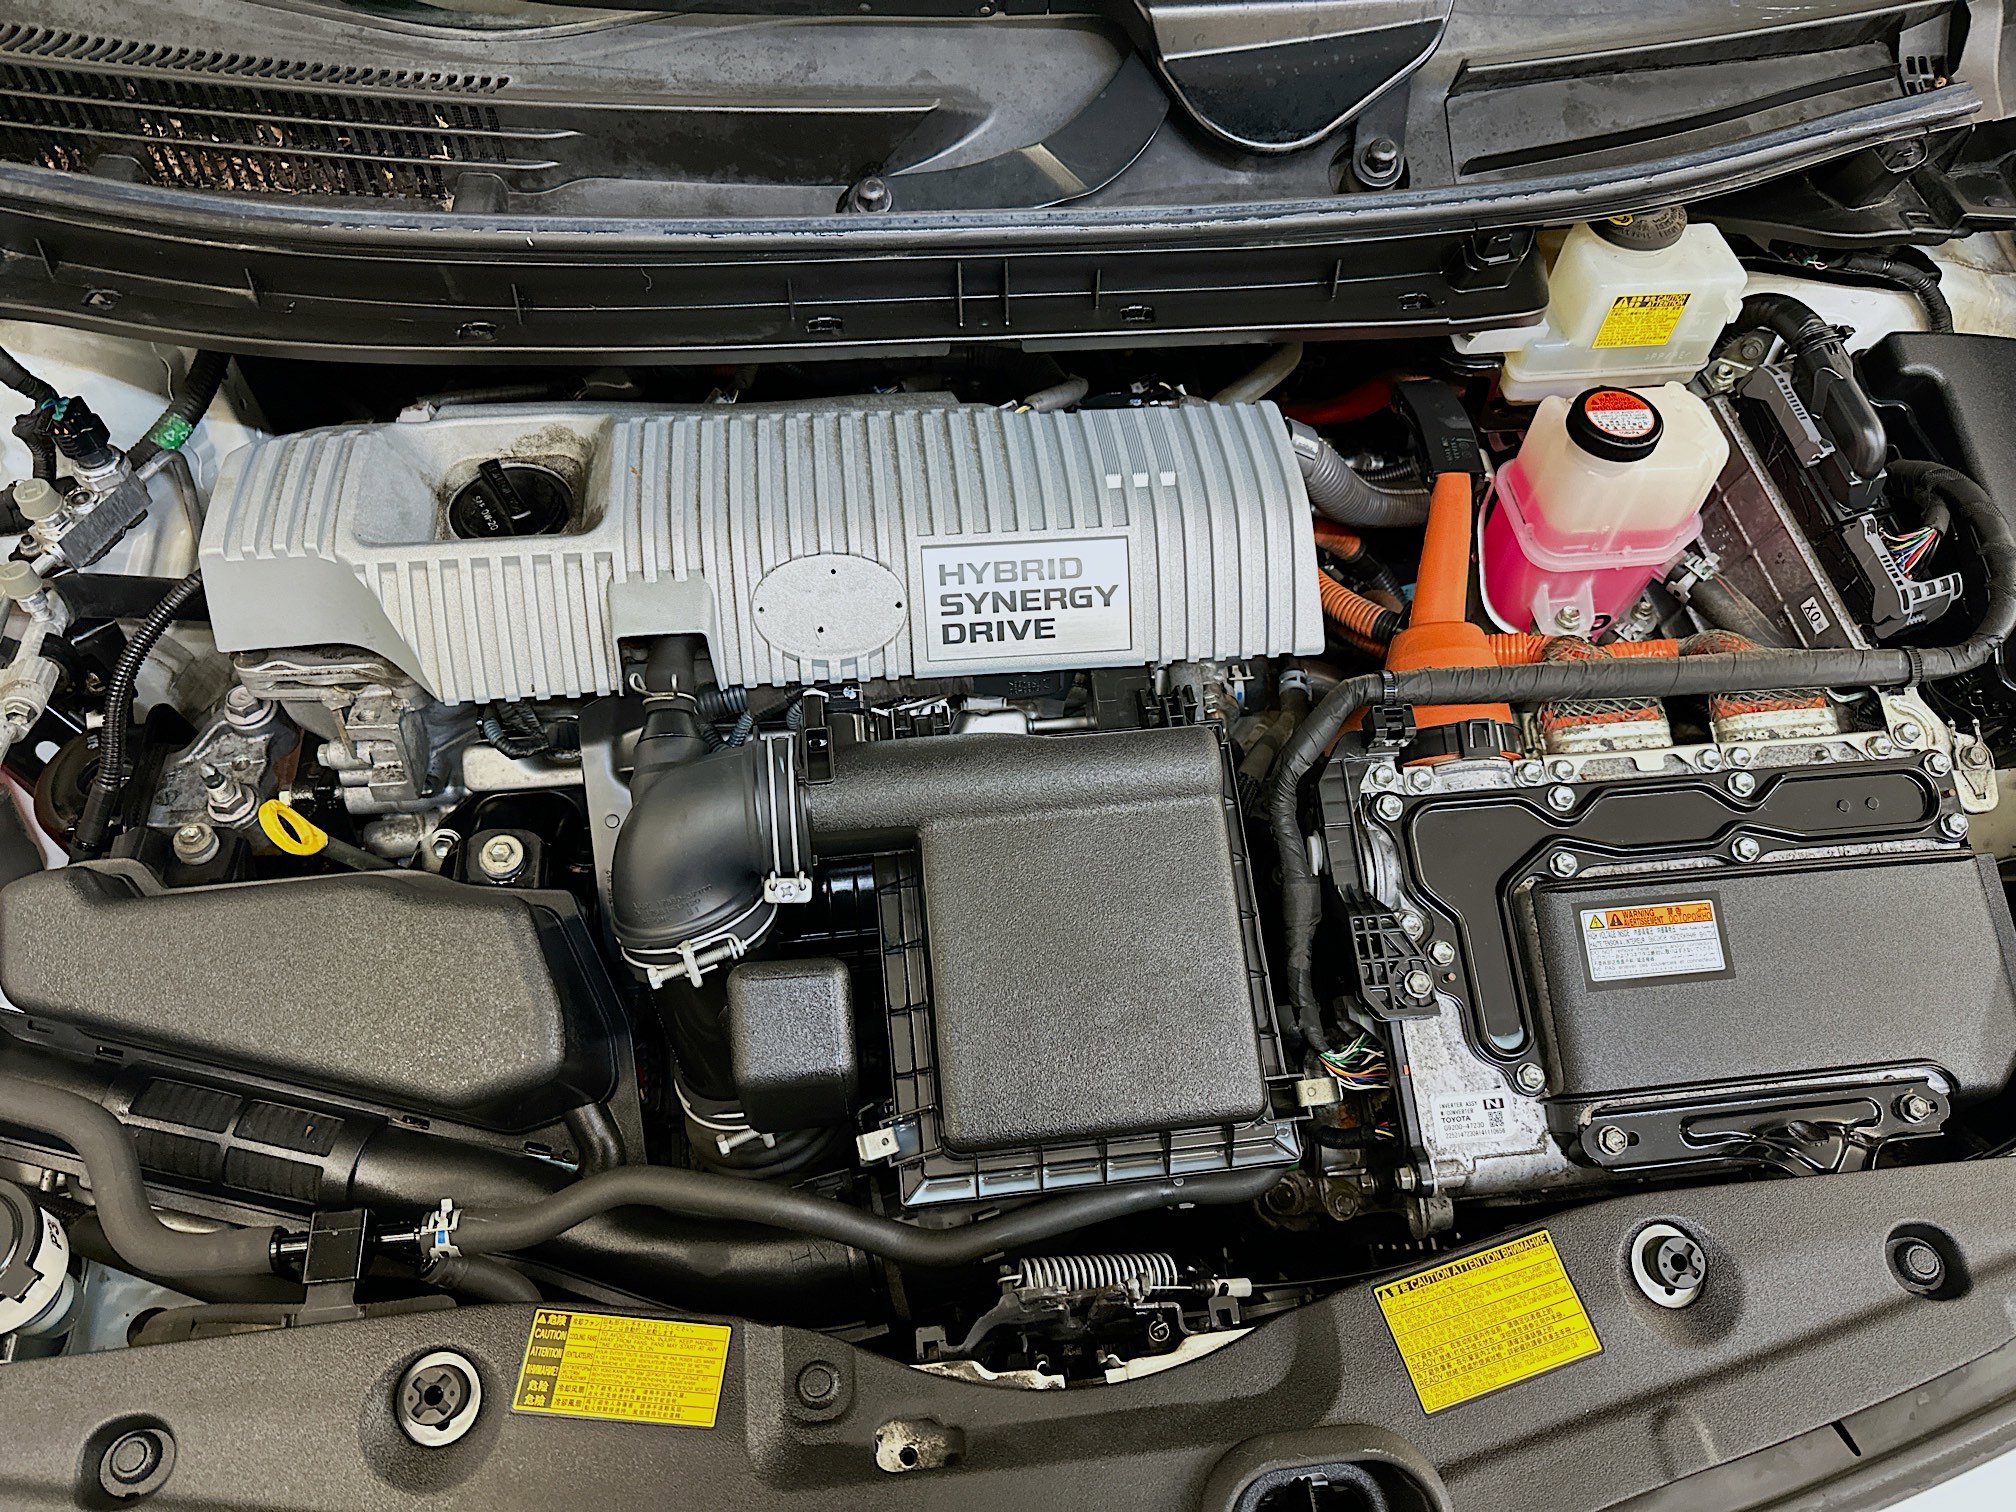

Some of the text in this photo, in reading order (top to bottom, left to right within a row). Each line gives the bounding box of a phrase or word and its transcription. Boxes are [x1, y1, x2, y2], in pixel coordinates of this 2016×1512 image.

[938, 557, 1083, 587] HYBRID
[940, 584, 1119, 617] SYNERGY
[941, 617, 1056, 645] DRIVE
[1622, 909, 1654, 918] WARNING
[1623, 916, 1664, 927] AVERTISSEMENT
[1441, 1115, 1471, 1123] TOYOTA
[1501, 1235, 1546, 1257] ВНИМАНИЕ
[1409, 1250, 1501, 1288] CAUTION ATTENTION
[534, 1328, 567, 1340] CAUTION
[529, 1345, 563, 1358] ATTENTION
